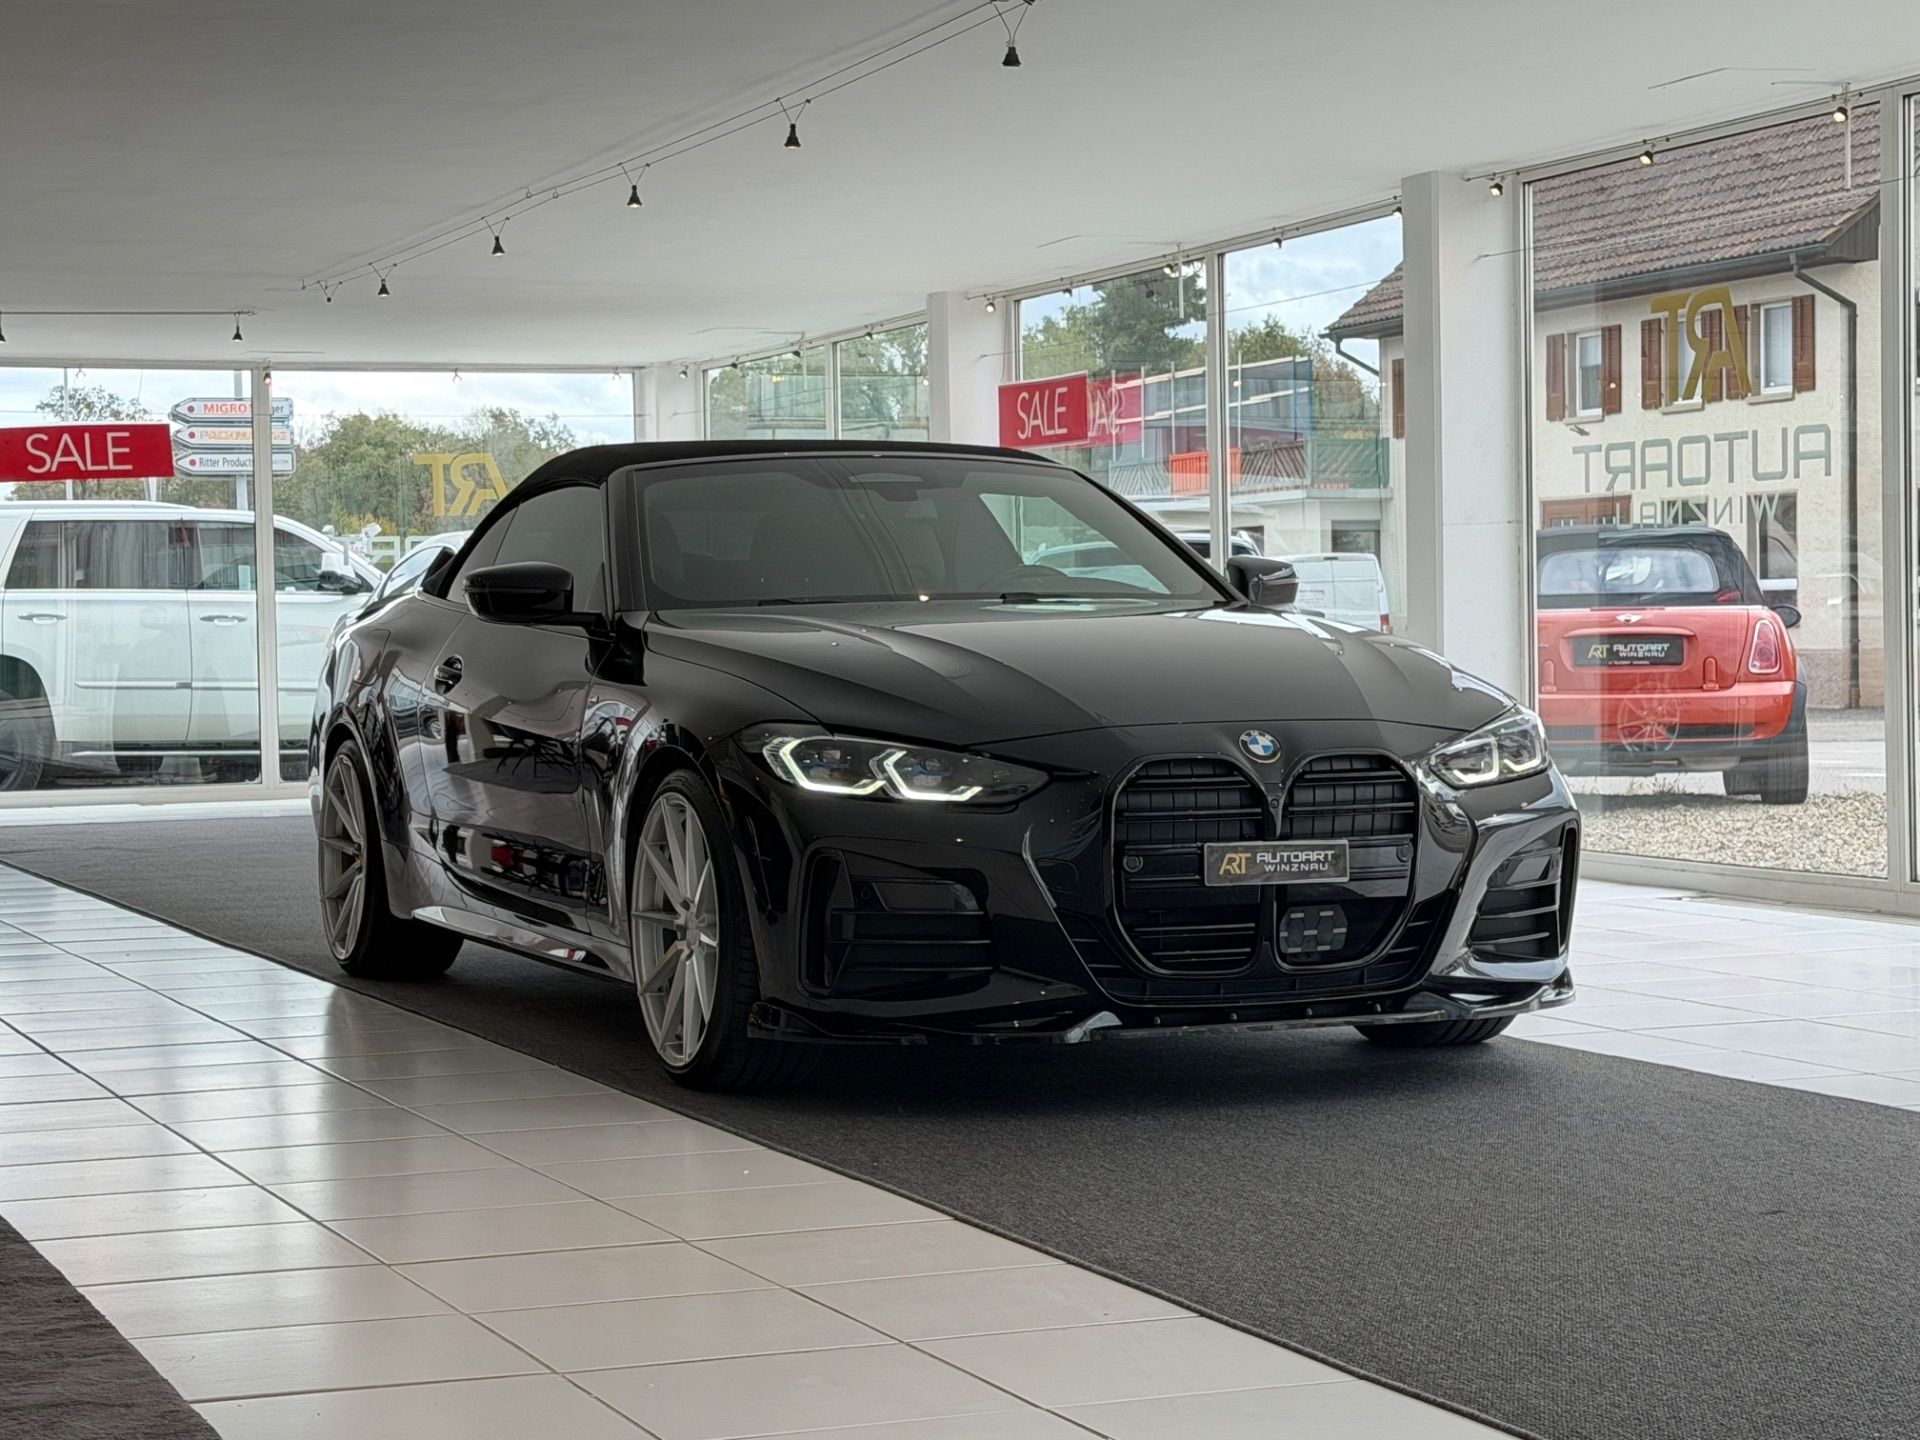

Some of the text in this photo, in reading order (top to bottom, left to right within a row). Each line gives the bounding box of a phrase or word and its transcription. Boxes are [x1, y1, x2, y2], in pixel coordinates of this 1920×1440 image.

[1017, 387, 1068, 440] SALE
[26, 432, 133, 473] SALE
[199, 457, 219, 468] Ritter
[1588, 645, 1610, 659] ART
[1613, 643, 1670, 652] AUTOART
[1218, 853, 1251, 875] ART
[1256, 850, 1335, 864] AUTOART
[1264, 862, 1329, 873] WINZNAU
